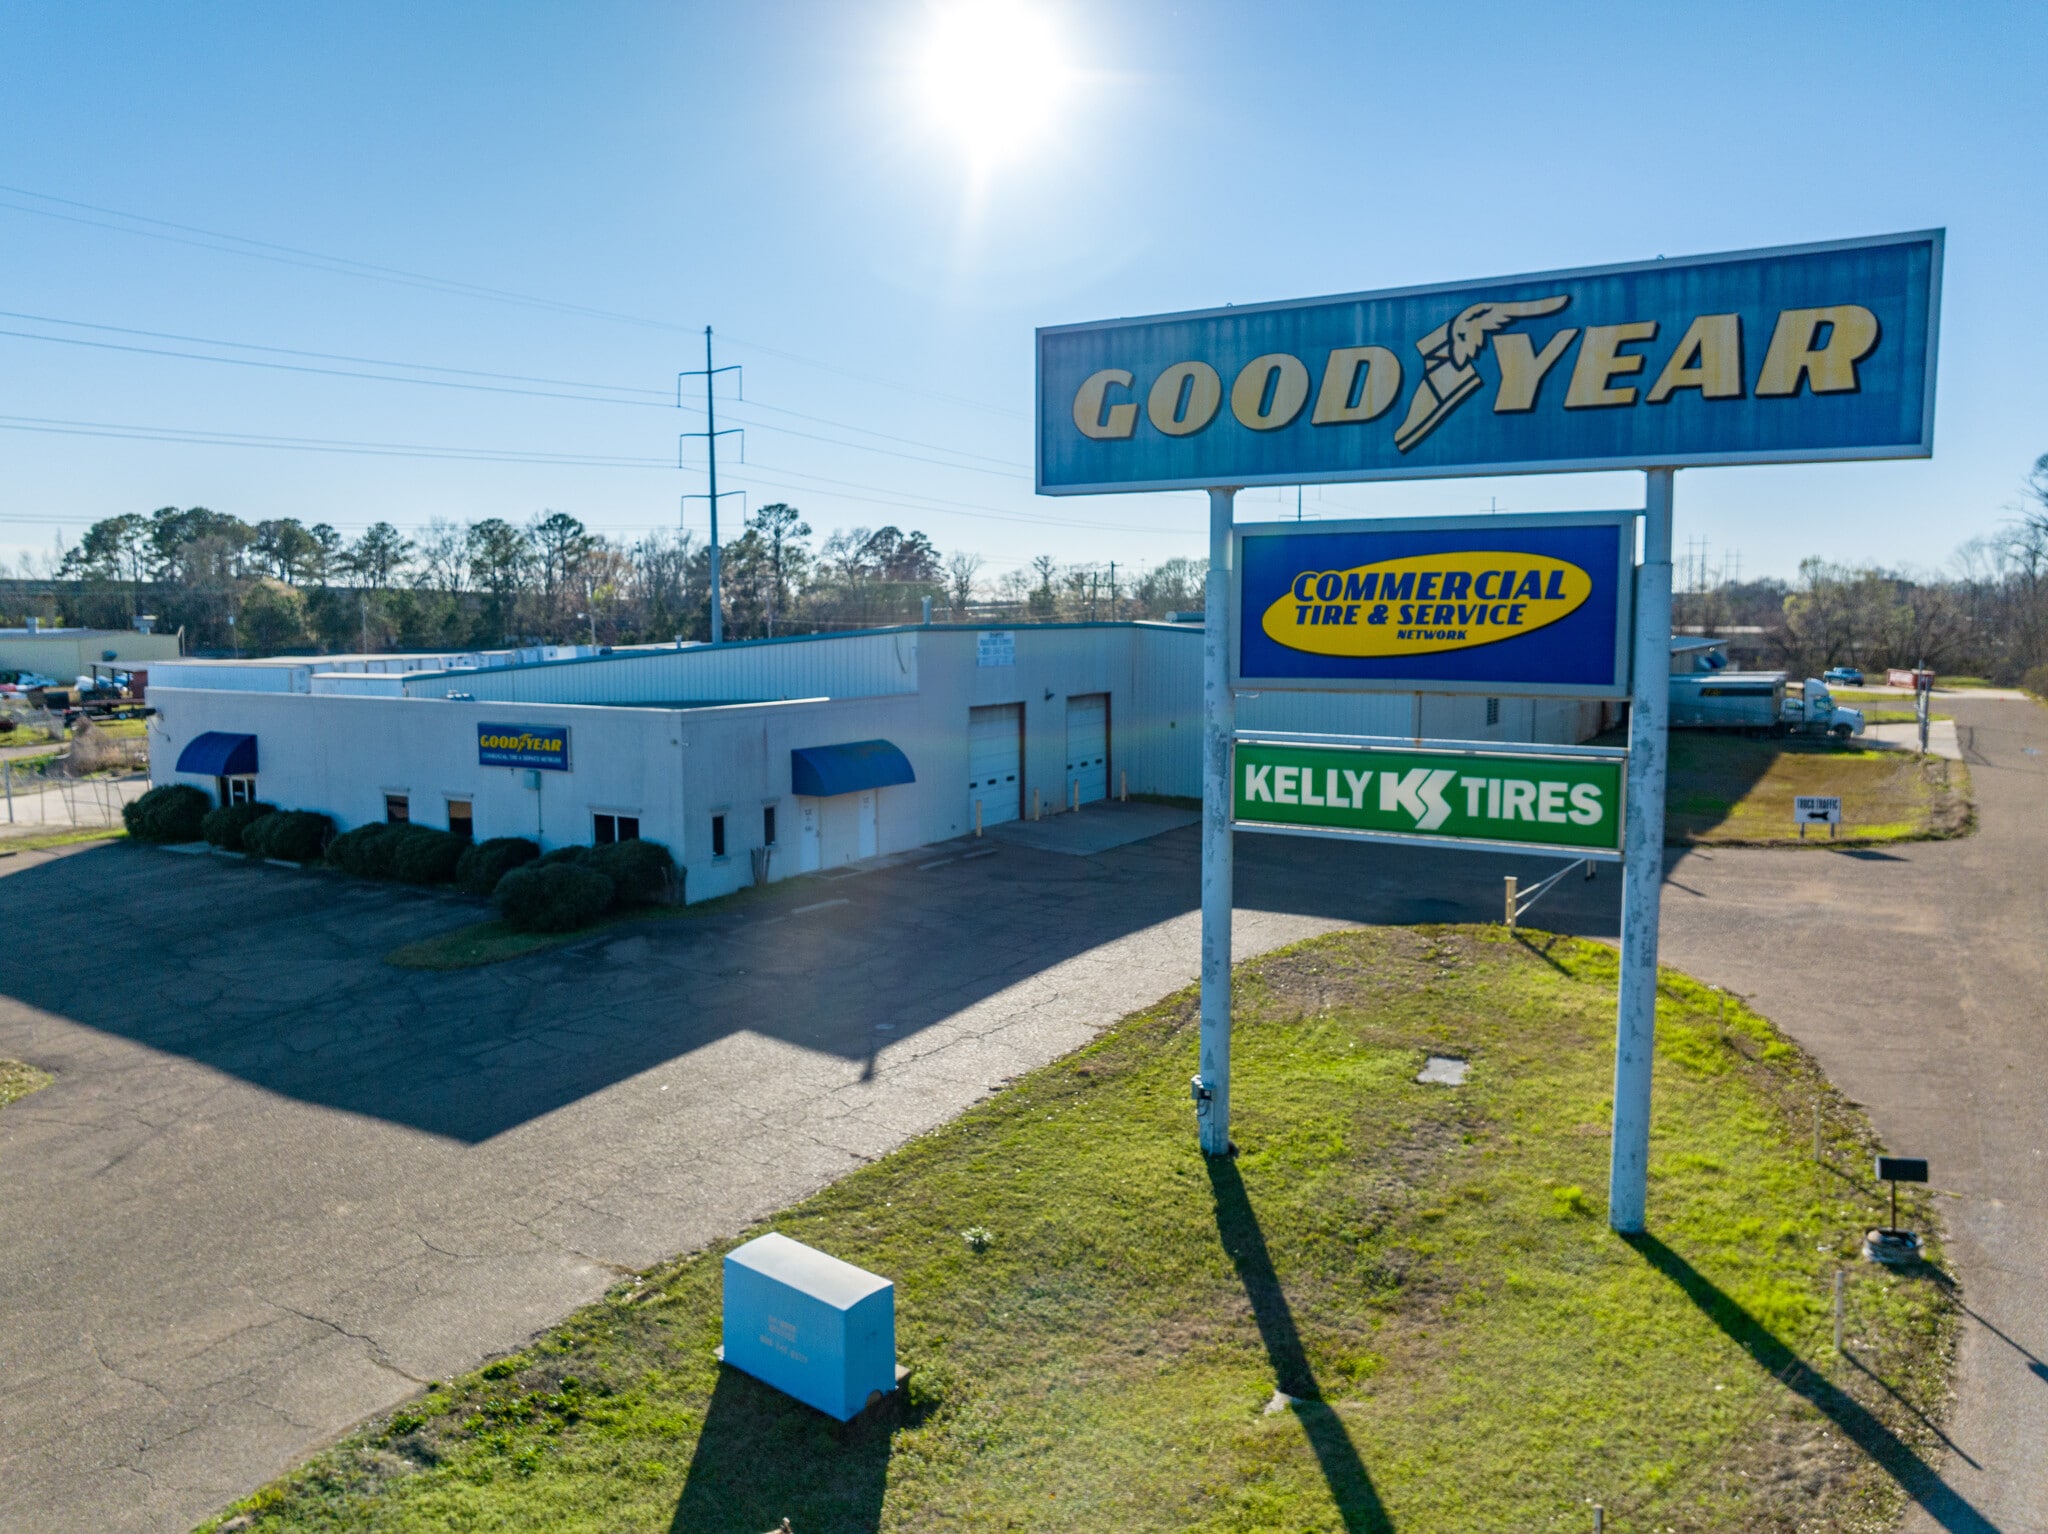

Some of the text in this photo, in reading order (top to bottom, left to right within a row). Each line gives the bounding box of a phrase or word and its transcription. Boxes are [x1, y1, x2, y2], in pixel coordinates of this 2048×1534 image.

[1073, 297, 1879, 442] GOODYEAR
[1293, 570, 1566, 602] COMMERCIAL
[1295, 604, 1526, 626] TIRE & SERVICE
[1397, 629, 1467, 641] NETWORK
[480, 733, 562, 751] GOODYEAR
[1245, 764, 1373, 809] KELLY
[1460, 776, 1603, 825] TIRES
